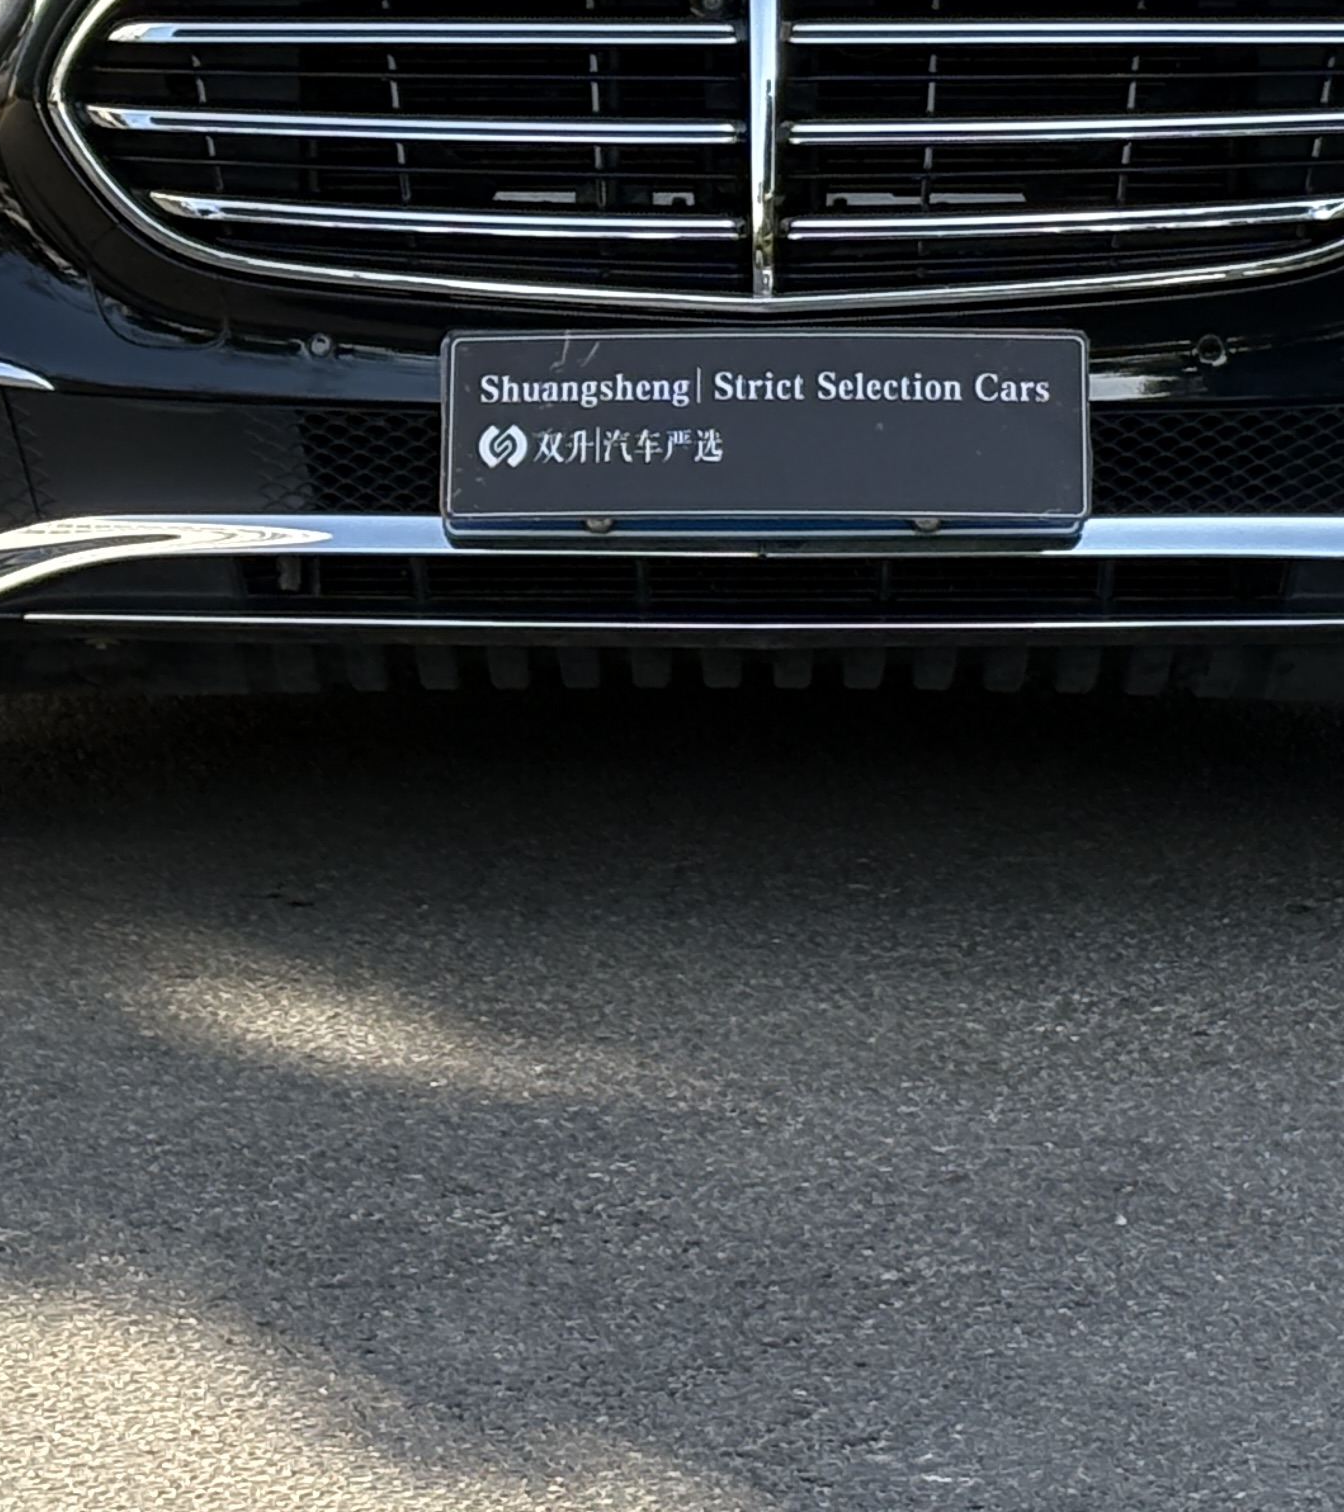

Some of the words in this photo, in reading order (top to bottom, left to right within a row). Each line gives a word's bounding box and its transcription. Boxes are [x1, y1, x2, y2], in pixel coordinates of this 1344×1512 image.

[714, 371, 805, 401] Strict
[817, 371, 963, 401] Selection
[974, 372, 1050, 403] Cars
